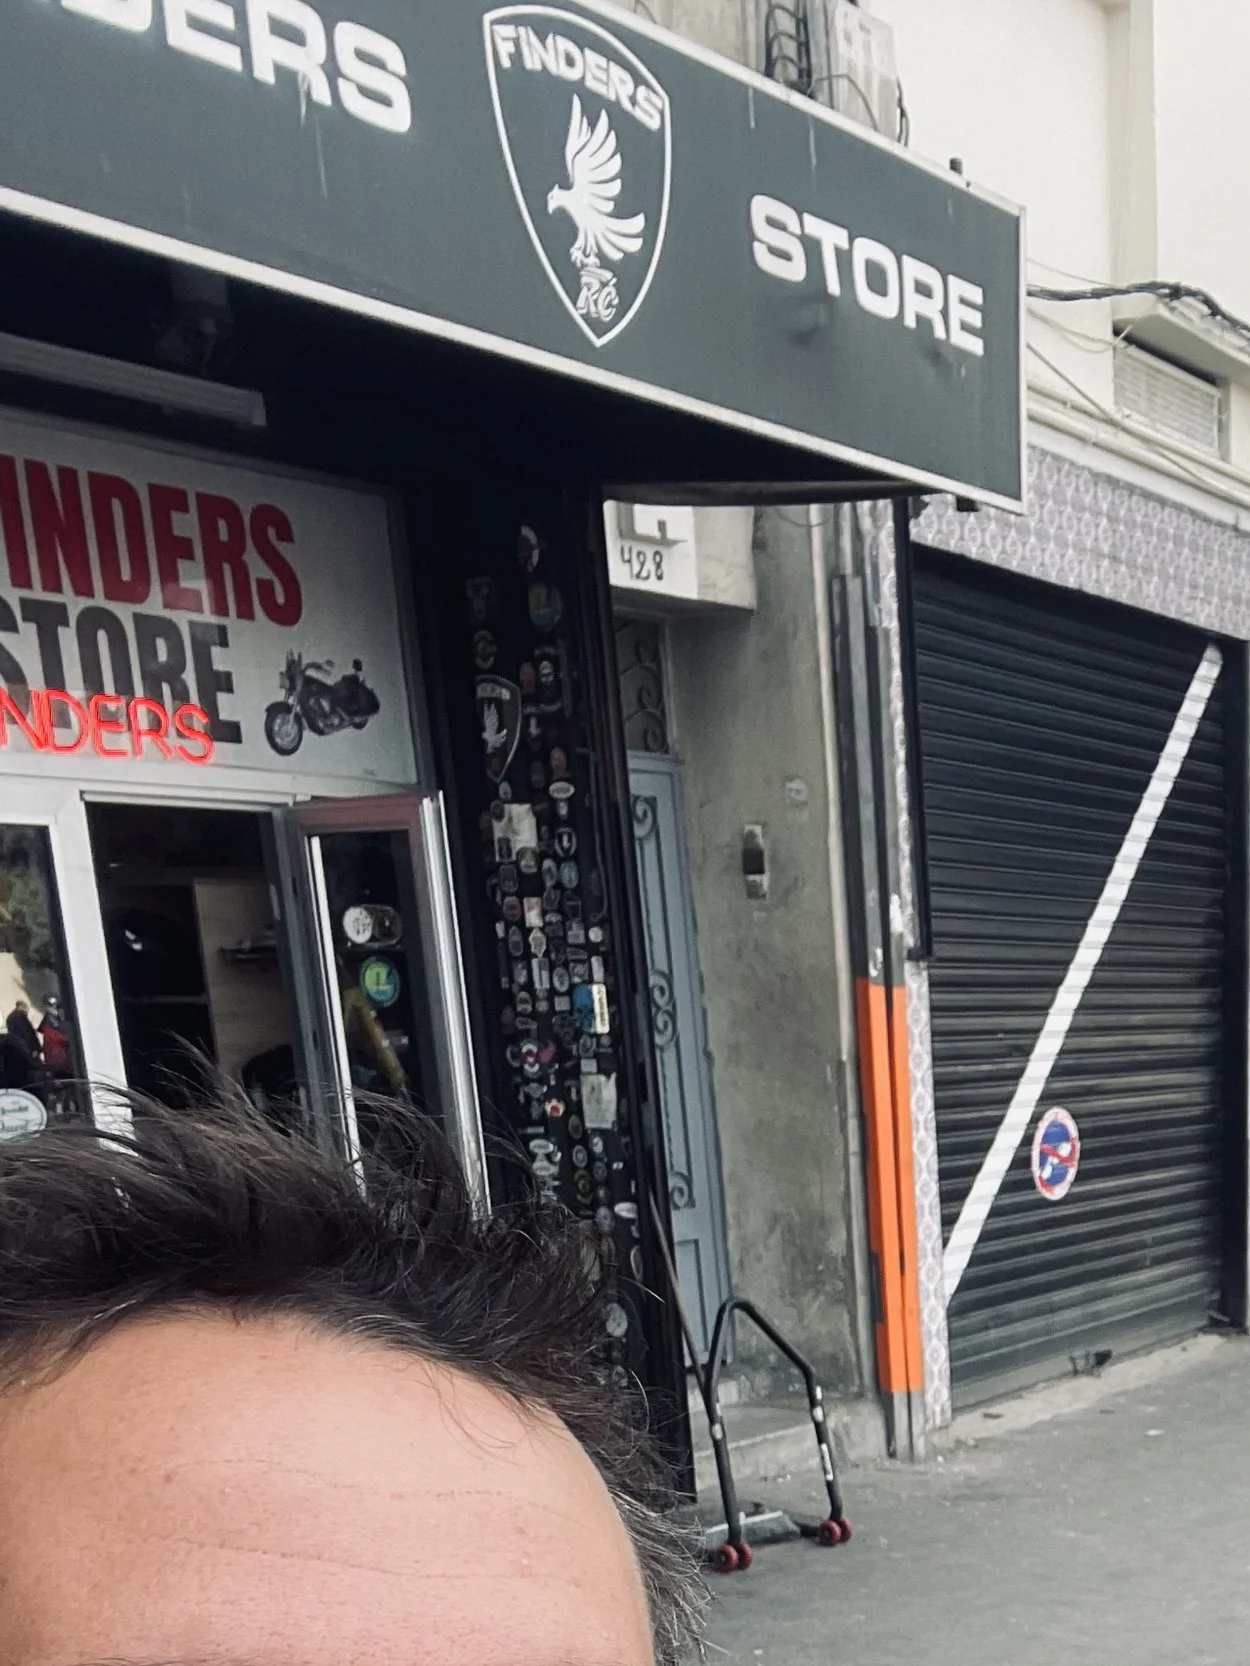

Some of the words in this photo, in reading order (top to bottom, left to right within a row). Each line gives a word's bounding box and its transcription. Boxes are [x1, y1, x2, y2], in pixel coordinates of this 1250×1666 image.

[492, 24, 664, 131] FINDERS
[751, 194, 984, 357] STORE
[620, 544, 664, 581] 428
